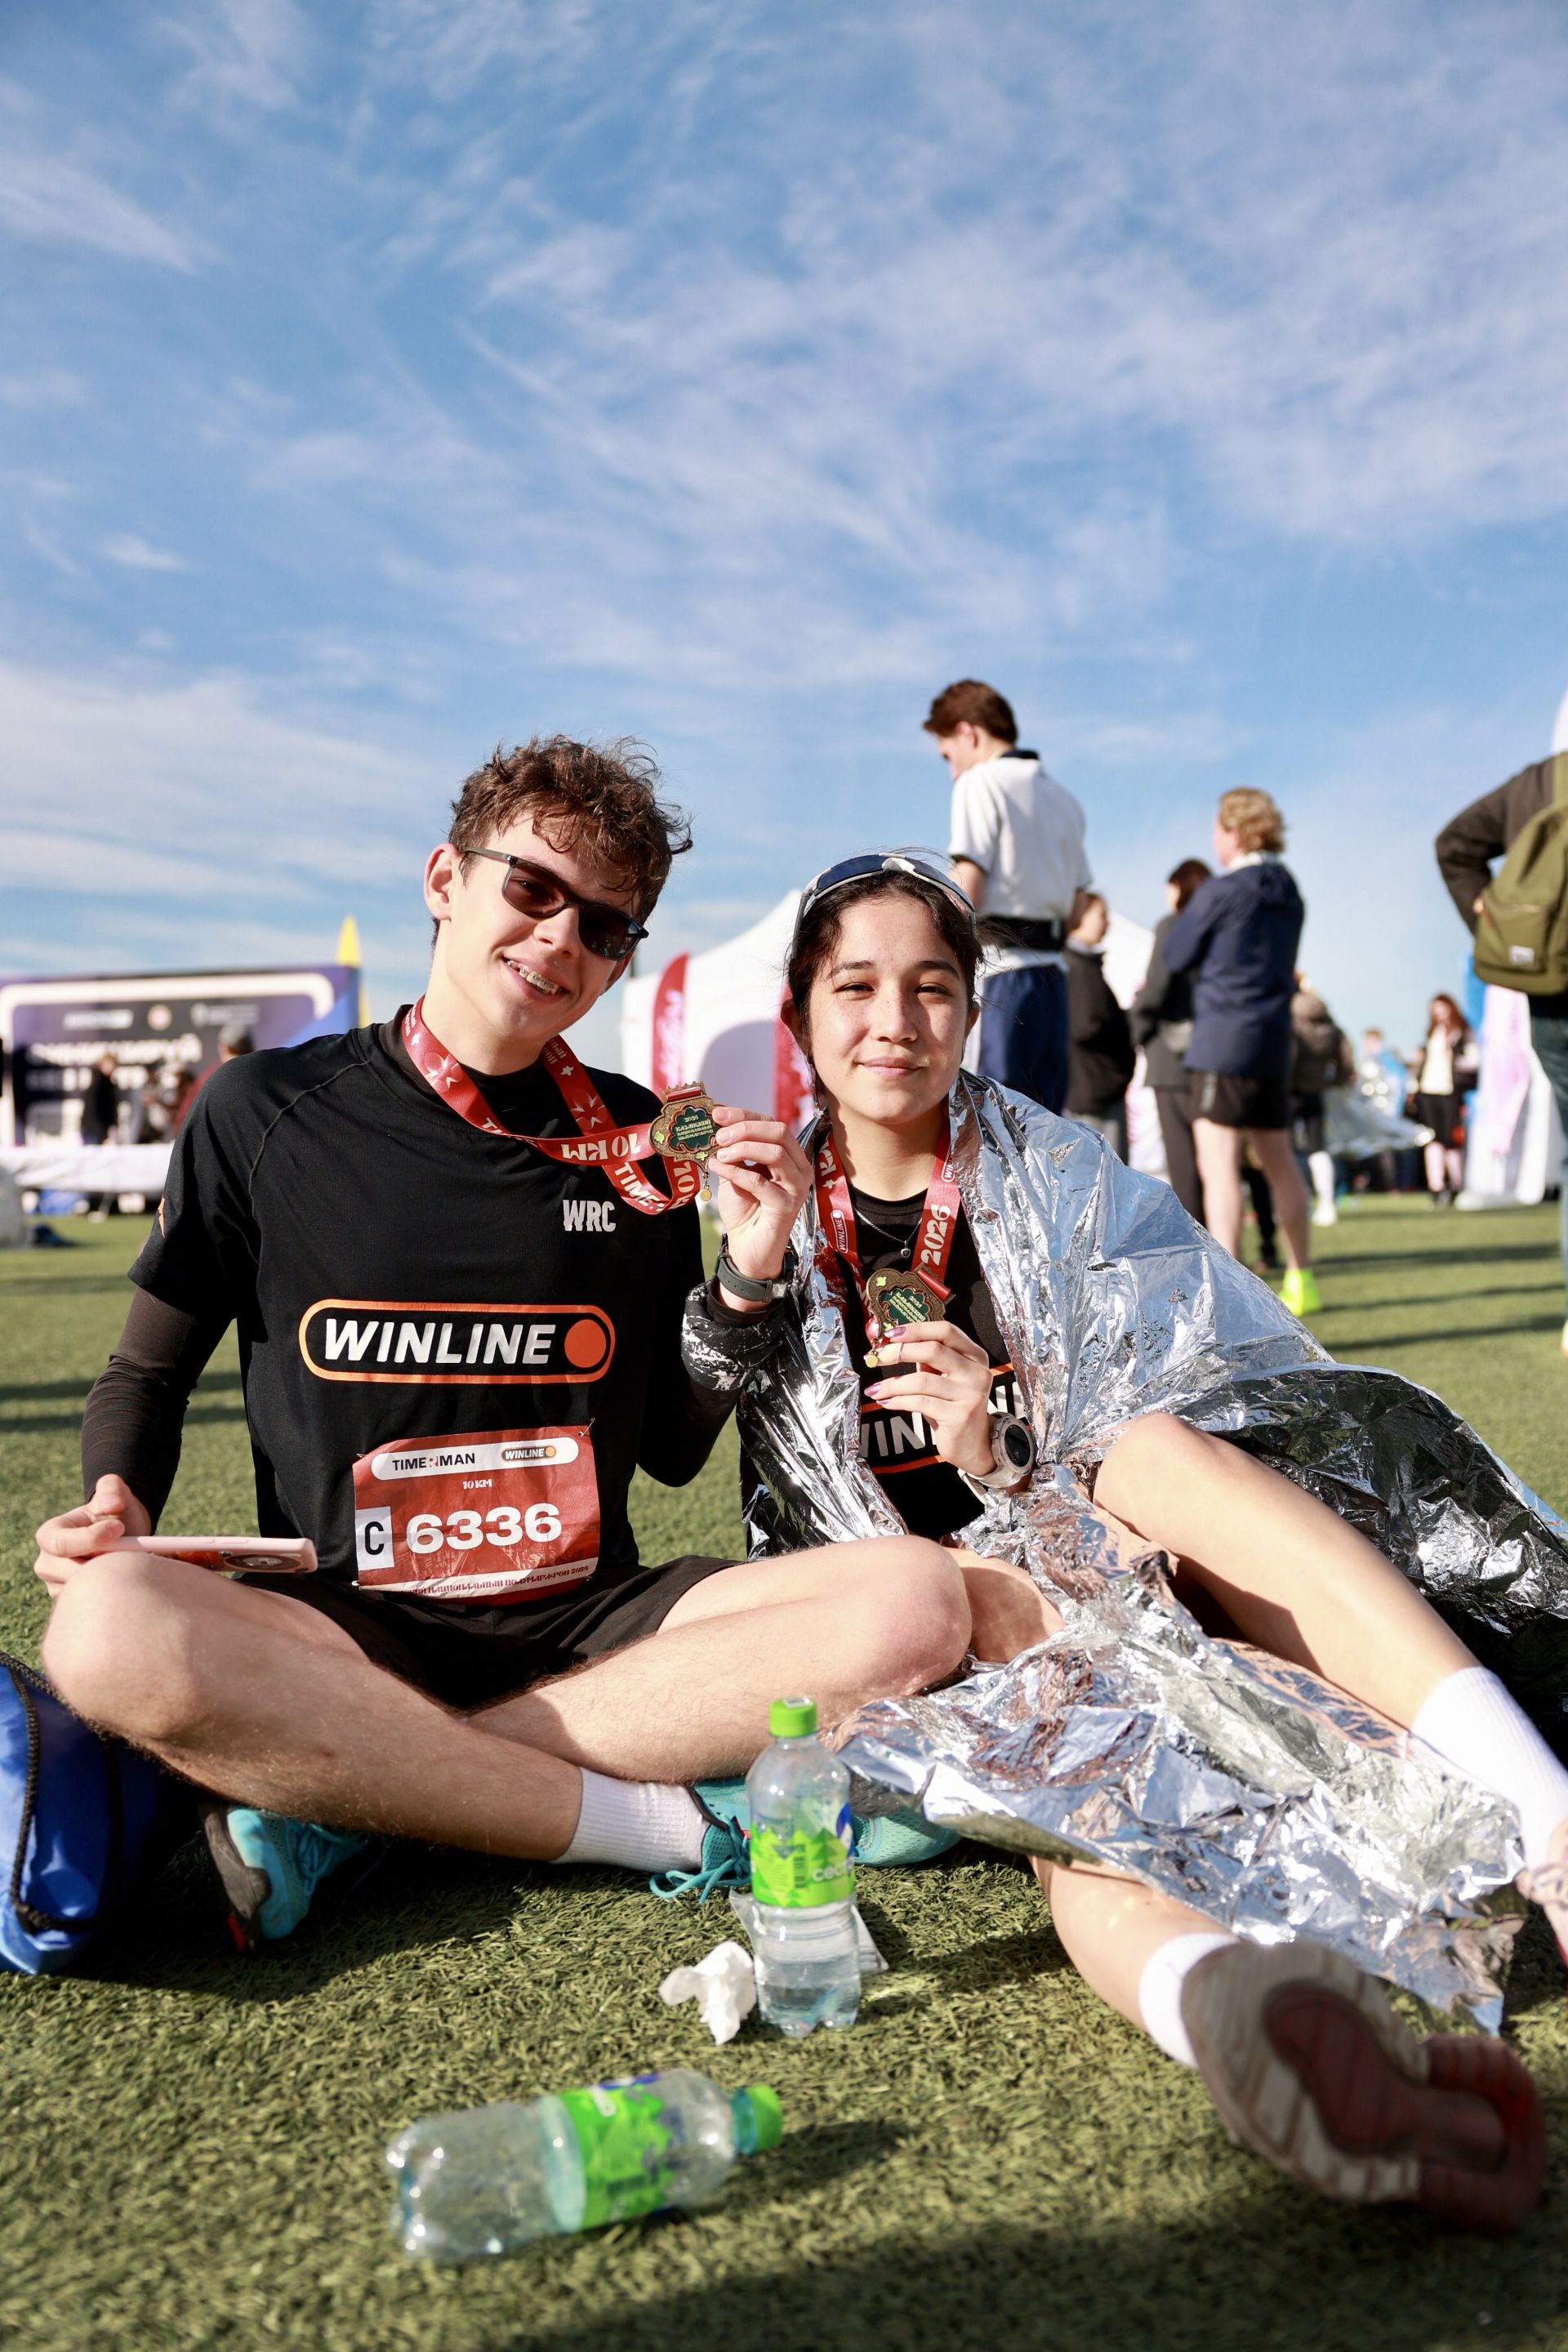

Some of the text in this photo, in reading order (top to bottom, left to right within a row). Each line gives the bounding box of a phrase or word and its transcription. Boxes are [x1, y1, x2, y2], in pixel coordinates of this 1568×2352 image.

[562, 1199, 617, 1232] WRC
[835, 1218, 847, 1251] WINLINE
[920, 1204, 951, 1266] 2026
[325, 1318, 556, 1364] WINLINE
[505, 1448, 545, 1460] WINLINE
[461, 1480, 474, 1490] 10
[364, 1503, 564, 1556] C 6336
